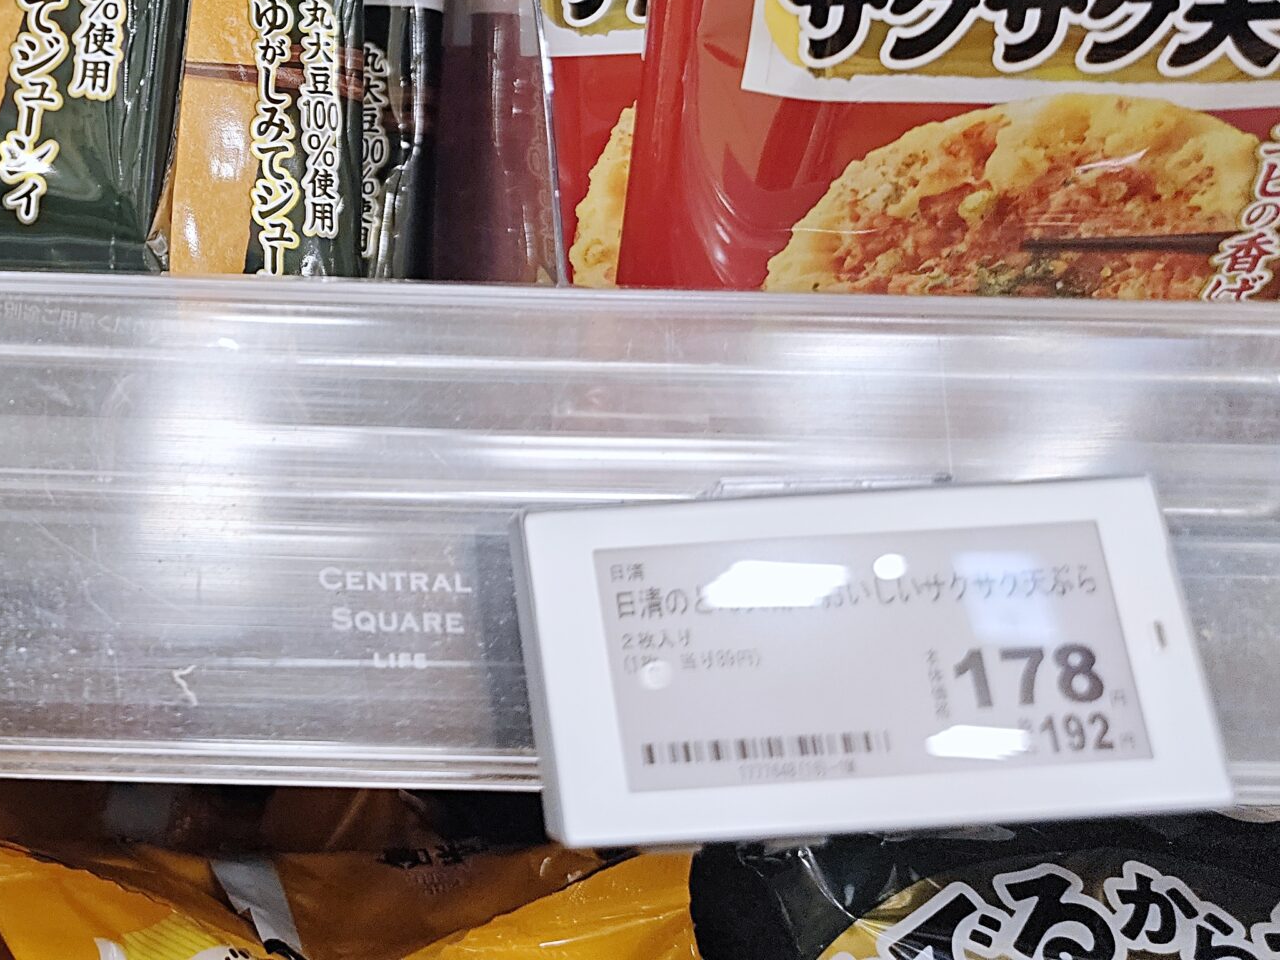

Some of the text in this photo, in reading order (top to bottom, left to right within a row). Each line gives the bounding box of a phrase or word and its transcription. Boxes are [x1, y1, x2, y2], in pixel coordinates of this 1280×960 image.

[318, 566, 473, 593] CENTRAL
[610, 562, 645, 582] 日清
[331, 606, 465, 634] SQUARE
[953, 643, 1105, 708] 178
[1039, 711, 1114, 753] 192
